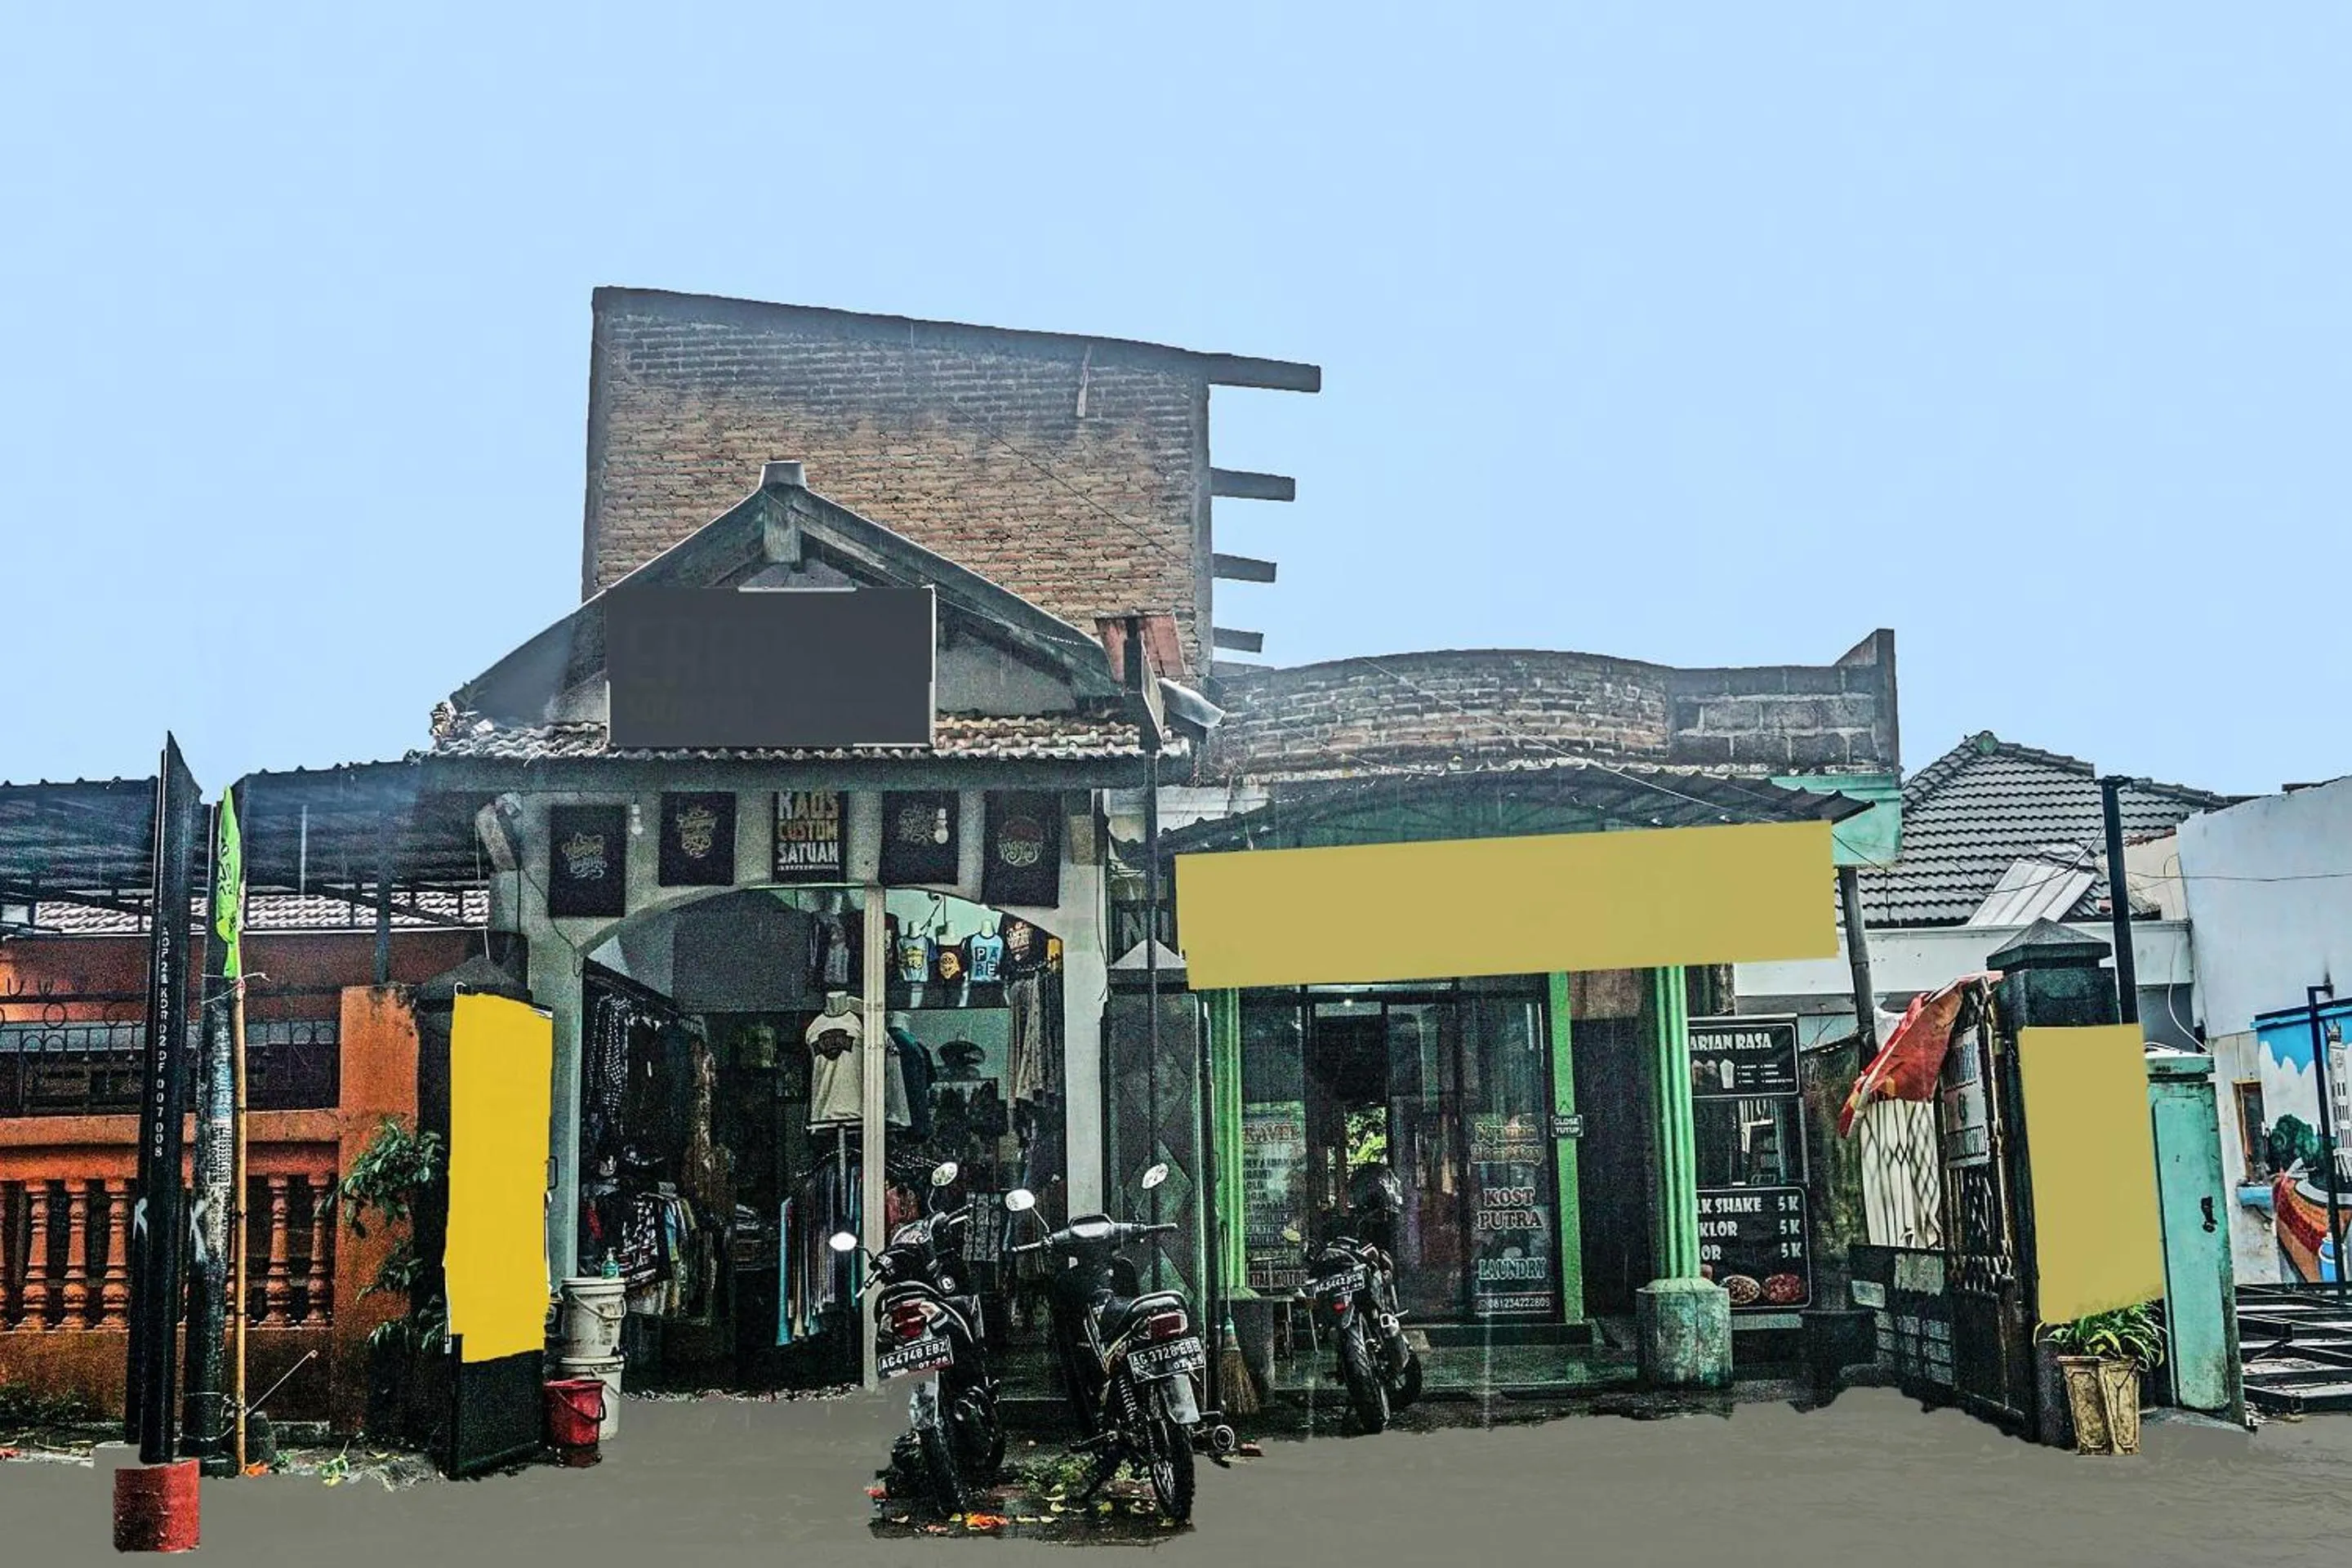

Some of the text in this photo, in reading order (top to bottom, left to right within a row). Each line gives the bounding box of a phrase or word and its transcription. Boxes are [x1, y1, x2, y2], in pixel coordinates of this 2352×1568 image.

[778, 788, 839, 819] KAOS
[778, 819, 838, 841] CUSTOM
[778, 842, 839, 863] SATUAN
[1735, 1032, 1772, 1049] RASA
[1553, 1117, 1579, 1126] CLOSE
[1555, 1126, 1580, 1134] TUTUP
[1483, 1187, 1535, 1207] KOST
[1715, 1197, 1762, 1213] SHAKE
[1477, 1209, 1544, 1230] PUTRA
[1699, 1220, 1738, 1237] KLOR
[1478, 1258, 1547, 1280] LAUNDRY
[882, 1356, 895, 1370] AG
